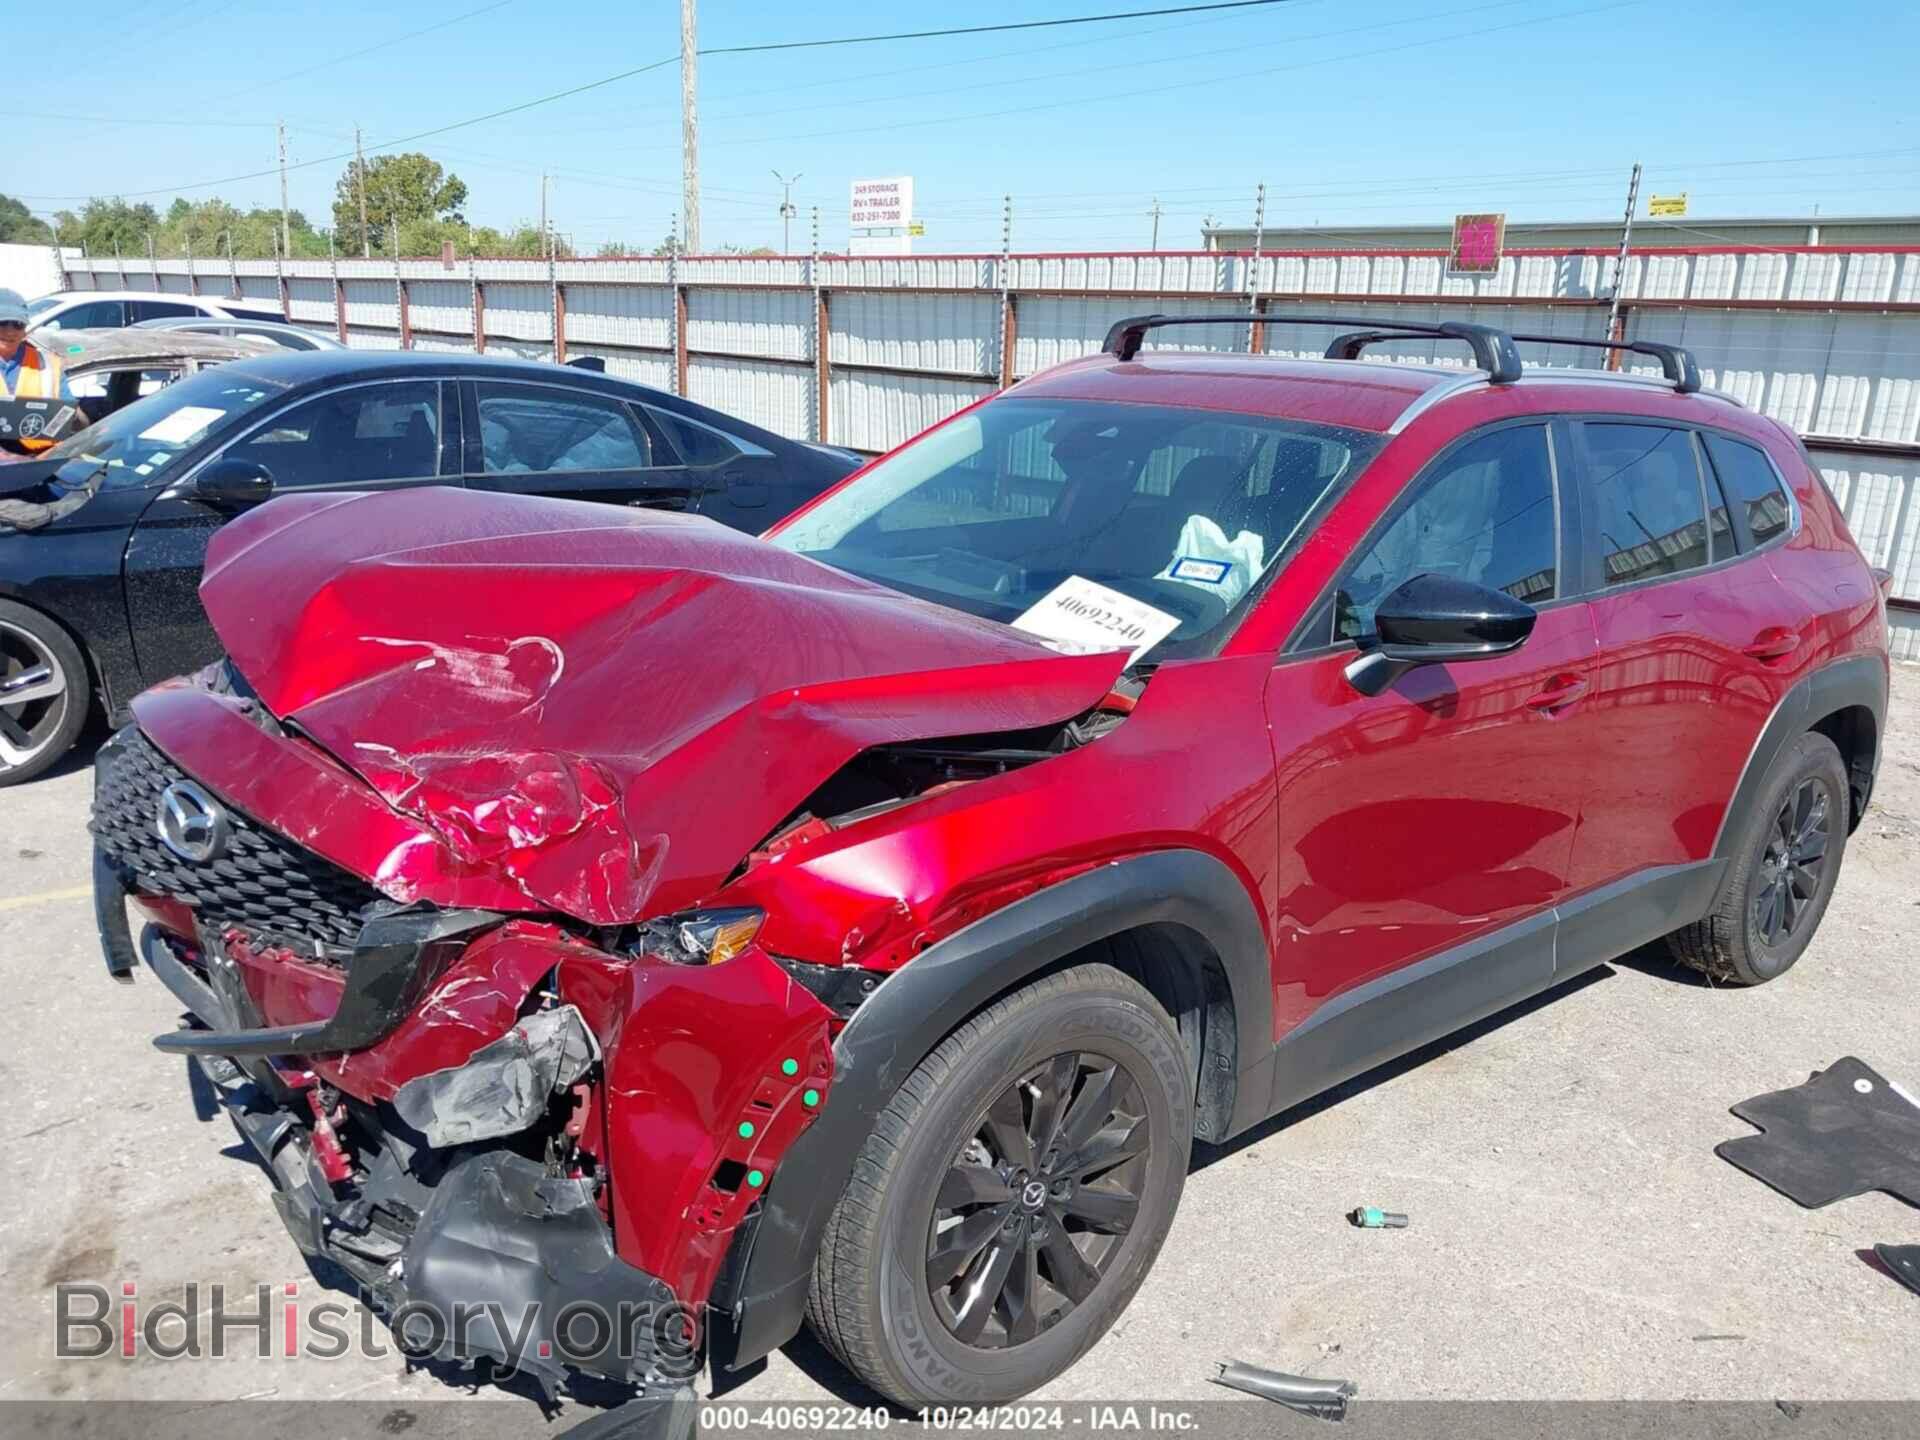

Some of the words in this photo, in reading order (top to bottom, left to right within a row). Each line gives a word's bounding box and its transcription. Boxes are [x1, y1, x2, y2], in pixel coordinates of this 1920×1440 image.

[867, 184, 899, 193] STORAGE
[853, 198, 863, 208] RV
[868, 197, 901, 207] TRAILER
[1055, 595, 1147, 640] 40692240
